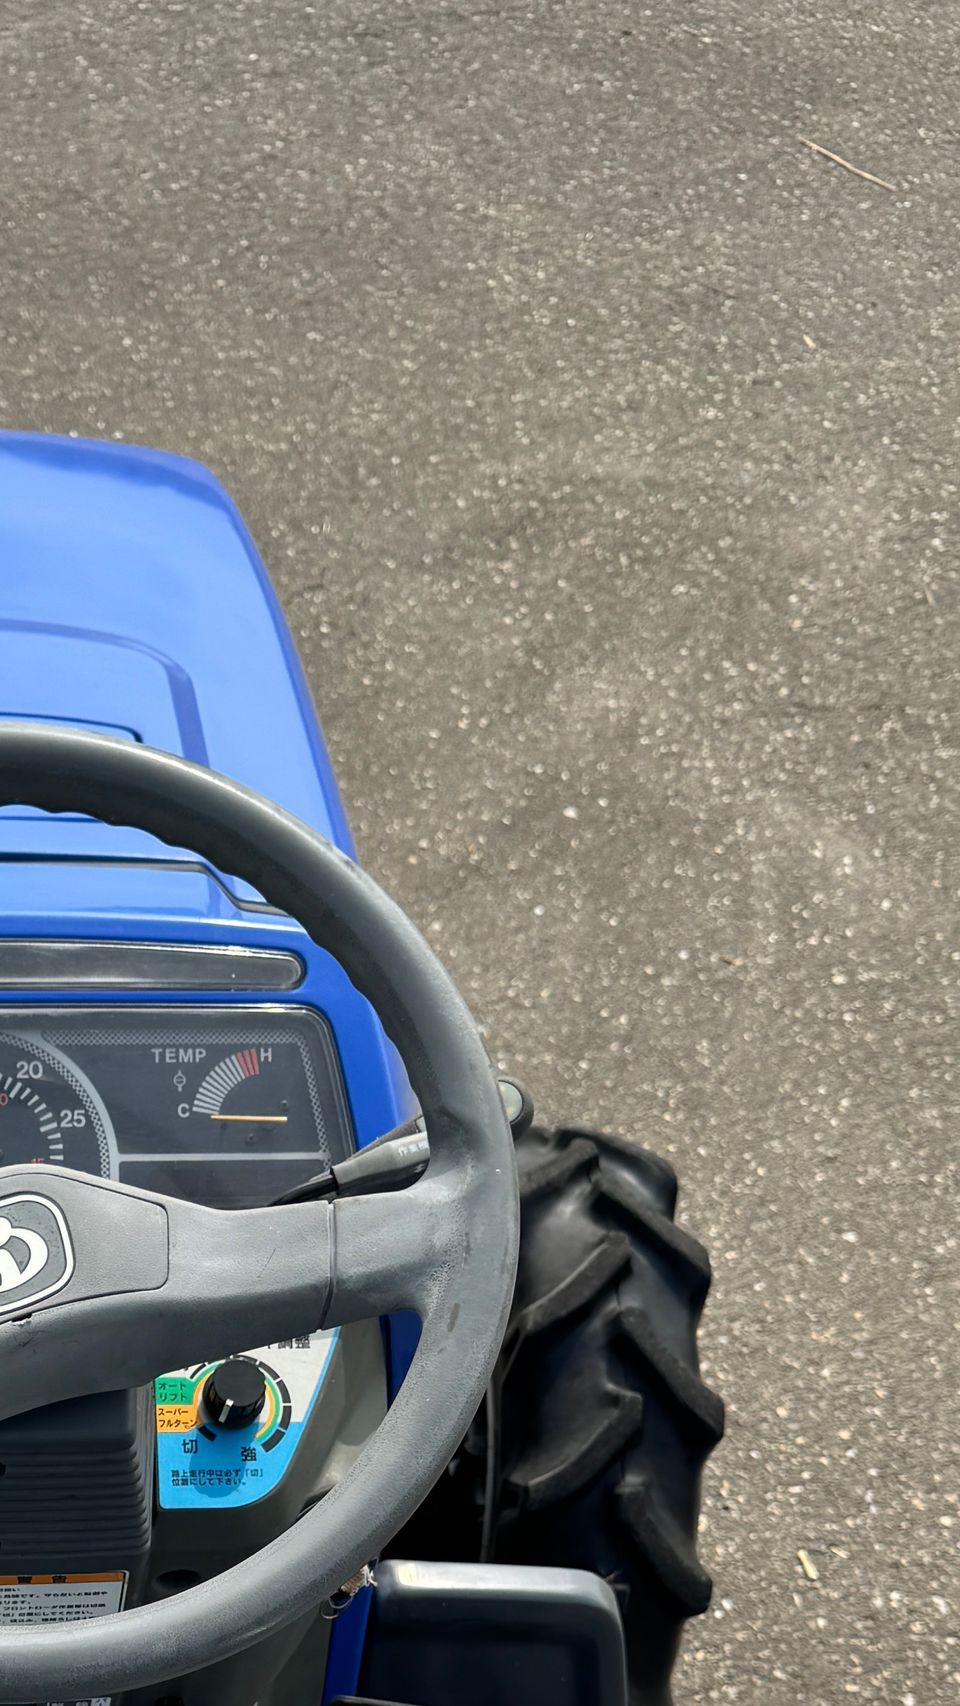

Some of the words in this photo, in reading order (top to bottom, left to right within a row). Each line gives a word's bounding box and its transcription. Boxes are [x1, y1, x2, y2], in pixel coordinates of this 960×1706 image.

[152, 1048, 206, 1063] TEMP
[261, 1048, 272, 1062] H
[16, 1061, 43, 1079] 20
[178, 1104, 189, 1117] C
[60, 1109, 86, 1127] 25
[158, 1382, 187, 1390] オート
[160, 1393, 187, 1401] リフト
[158, 1419, 197, 1427] フルターン
[182, 1439, 198, 1454] 切
[241, 1446, 256, 1461] 強
